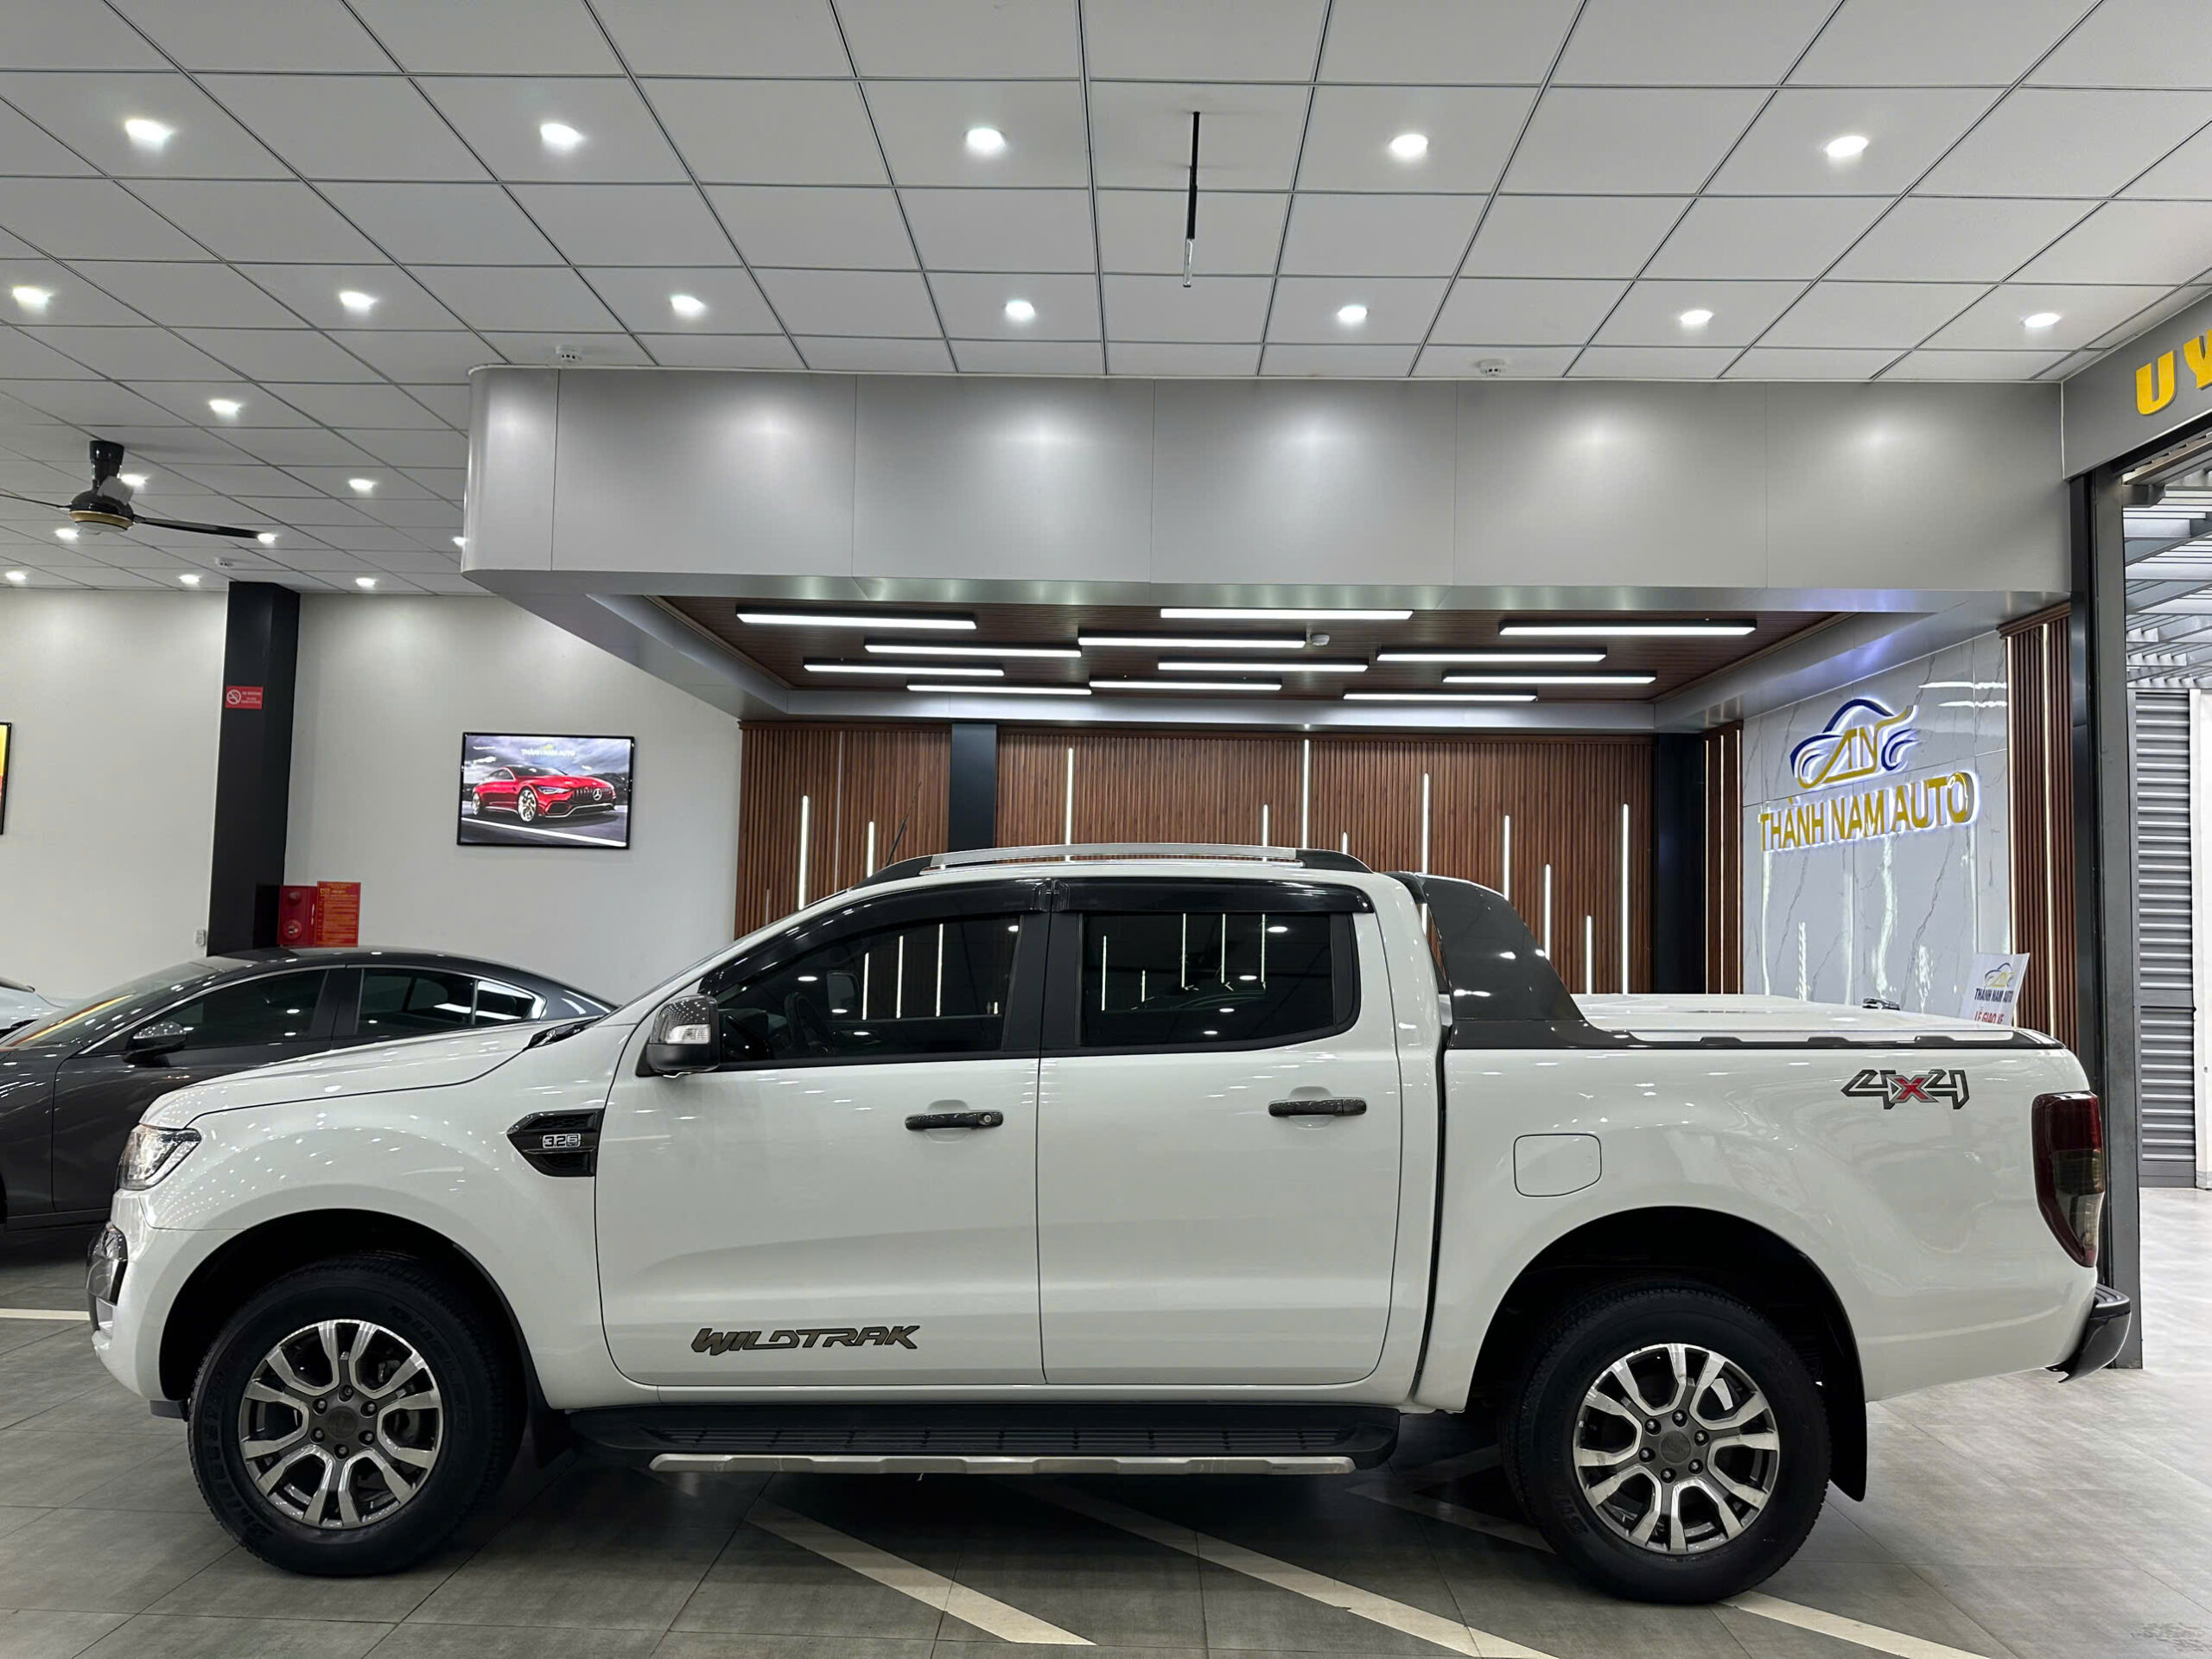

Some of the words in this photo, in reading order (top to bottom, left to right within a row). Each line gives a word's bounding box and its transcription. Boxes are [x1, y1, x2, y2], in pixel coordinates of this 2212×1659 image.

[1758, 796, 1825, 851] THÀNH
[1831, 789, 1890, 840] NAM
[1892, 772, 1974, 834] AUTO
[691, 1325, 920, 1356] WILDTRAK
